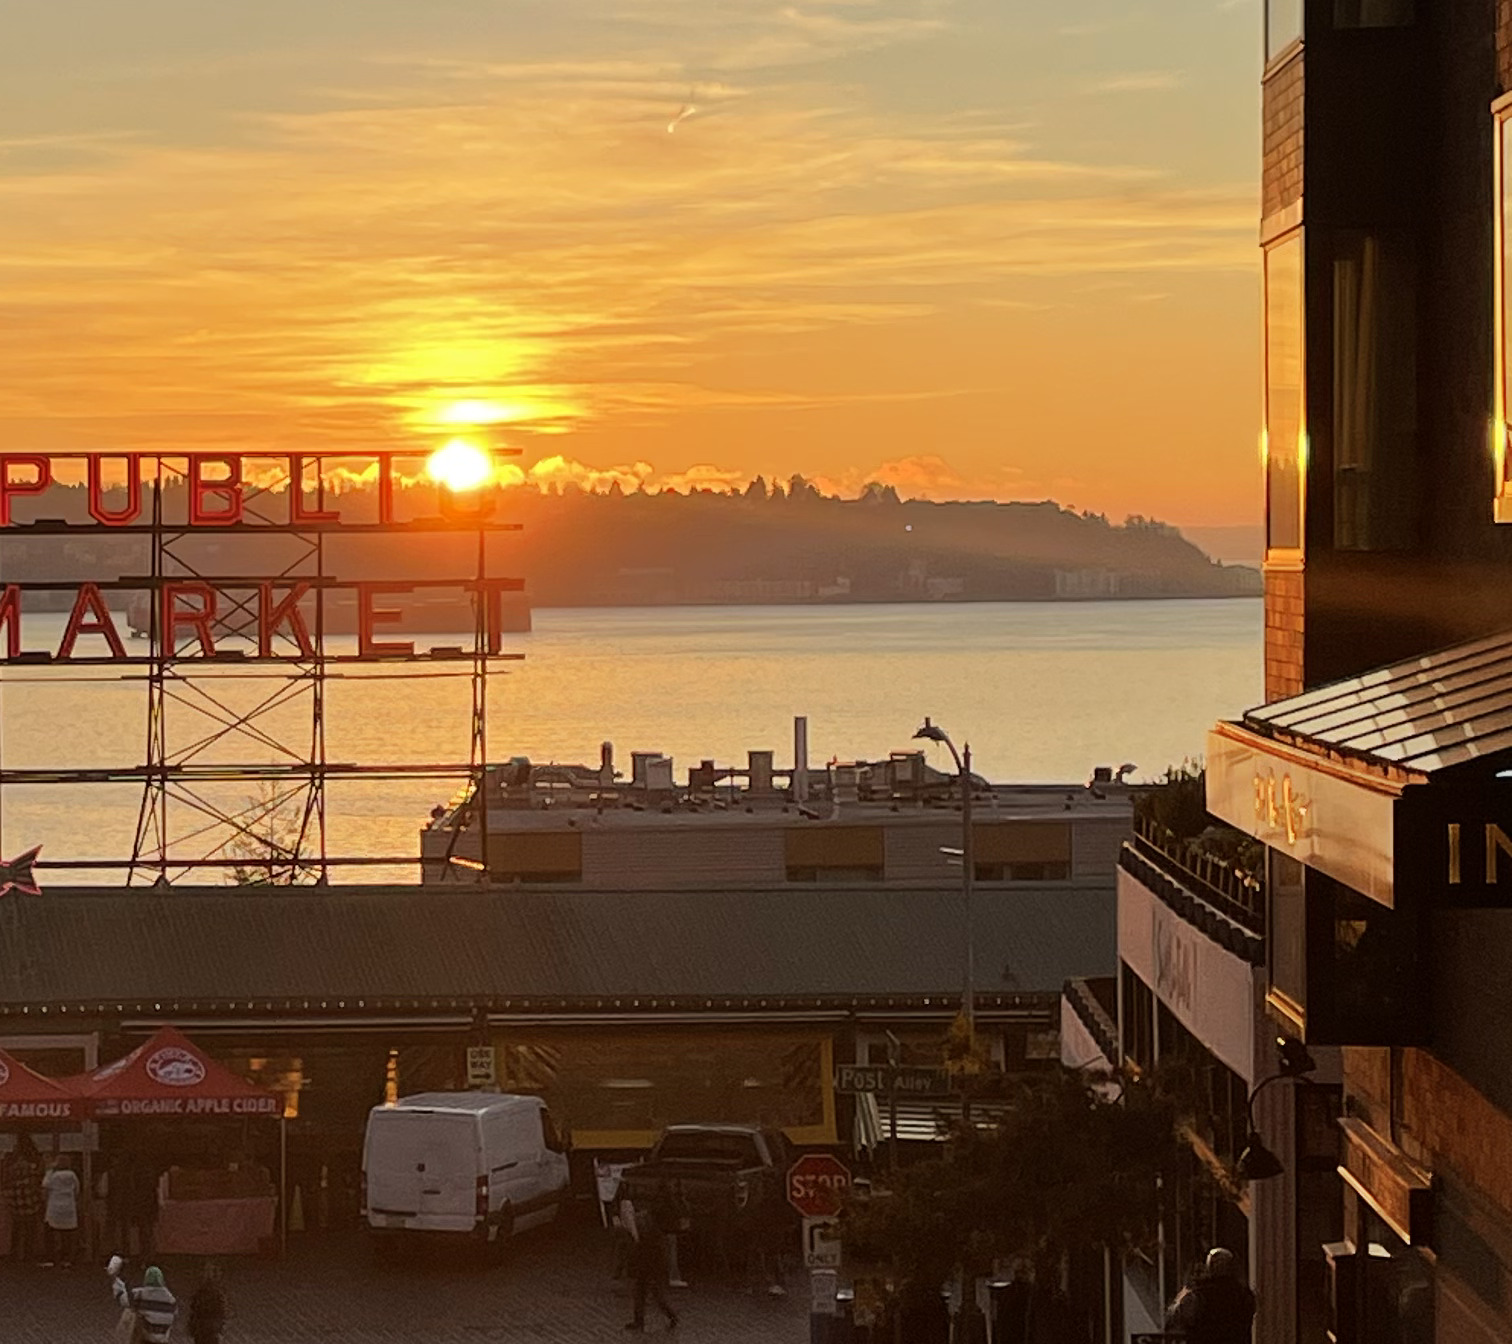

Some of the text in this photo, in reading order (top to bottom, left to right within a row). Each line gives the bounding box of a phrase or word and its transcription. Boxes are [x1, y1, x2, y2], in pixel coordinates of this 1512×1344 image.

[841, 1069, 931, 1092] Post Alley
[121, 1097, 277, 1115] ORGANIC APPLE CIDER
